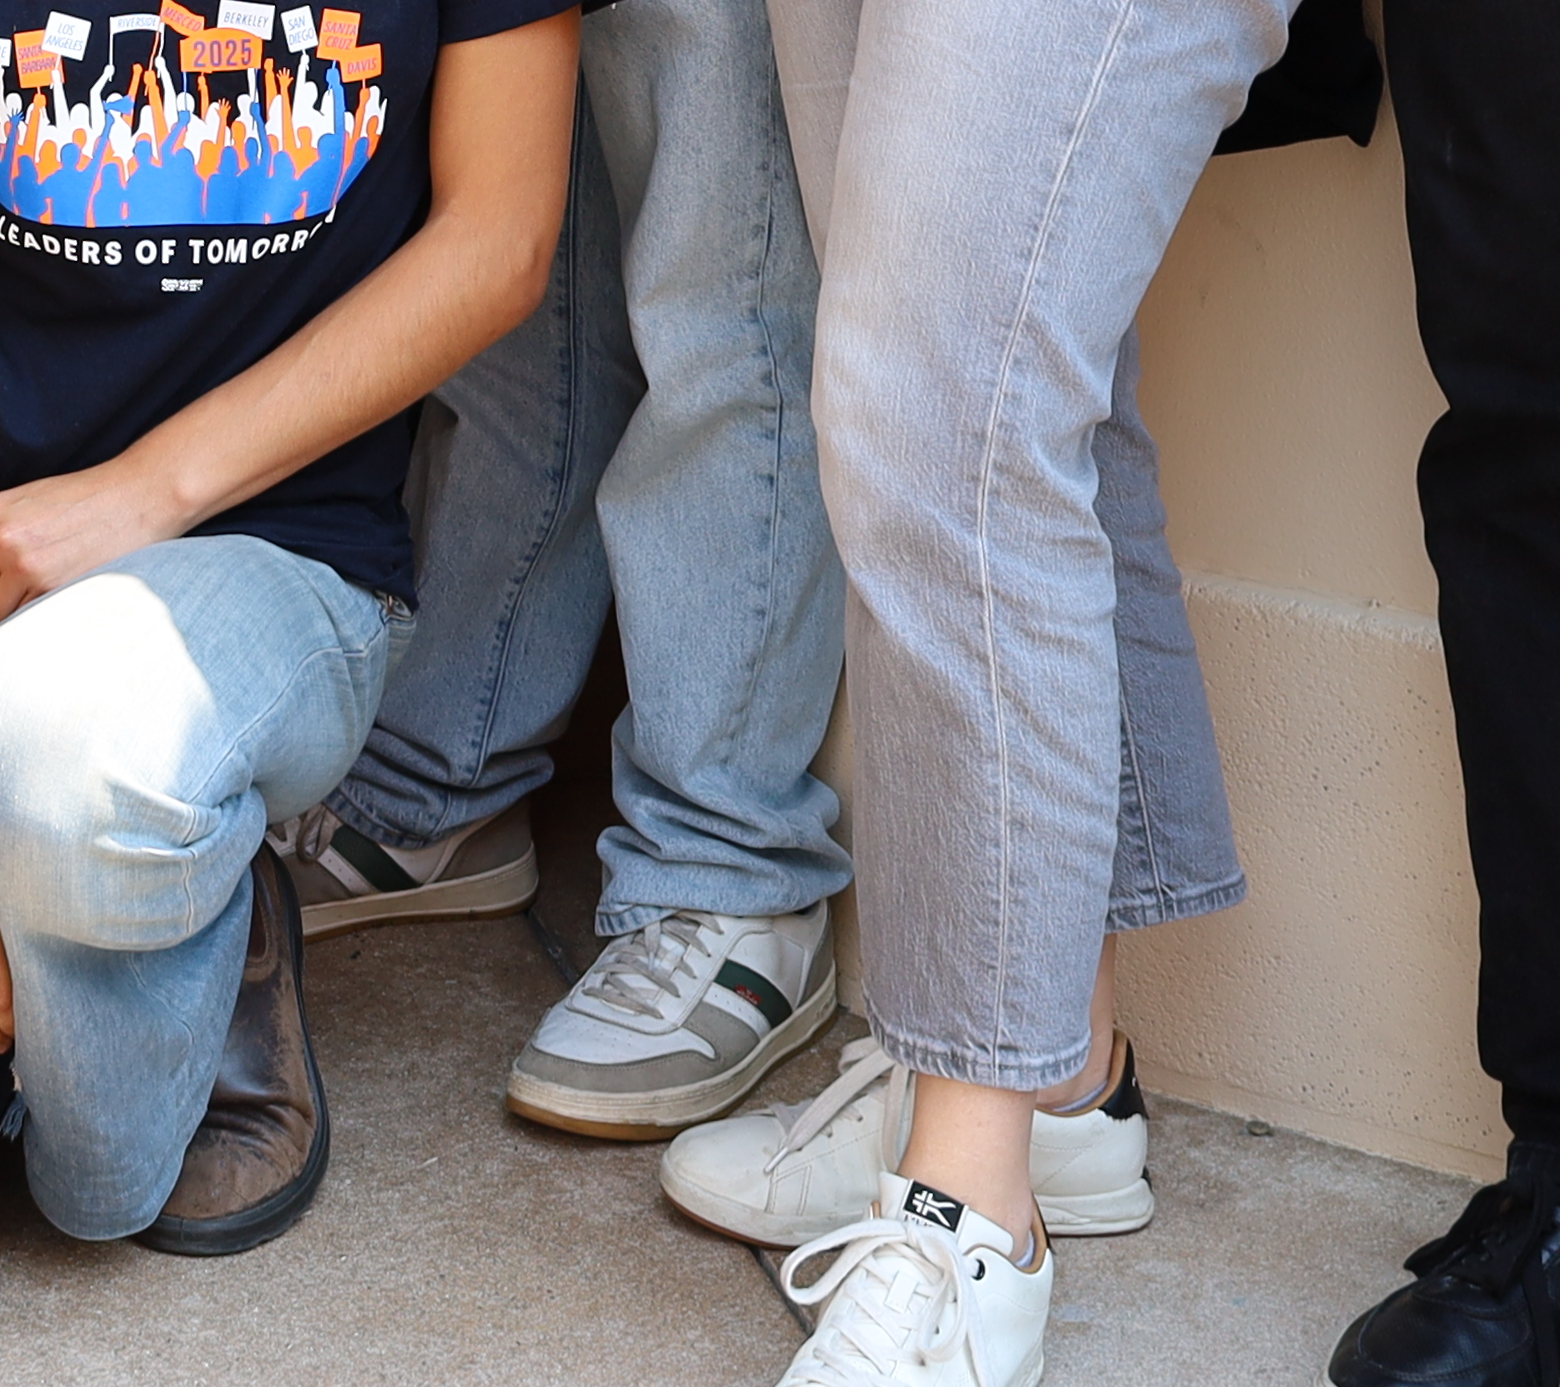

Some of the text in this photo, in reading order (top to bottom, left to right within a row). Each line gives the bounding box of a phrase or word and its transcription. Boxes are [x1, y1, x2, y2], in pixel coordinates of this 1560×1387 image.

[117, 16, 158, 28] RIVERSIDE
[164, 6, 203, 32] MERCED
[223, 11, 270, 28] BERKELEY
[288, 15, 307, 30] SAN
[57, 22, 75, 35] LOS
[323, 20, 357, 36] SANTA
[45, 36, 84, 52] ANGELES
[288, 28, 315, 46] DIEGO
[325, 35, 353, 50] CRUZ
[193, 38, 252, 68] 2025
[347, 58, 377, 74] DAVIS
[135, 239, 177, 265] OF
[188, 205, 336, 265] TOMORR
